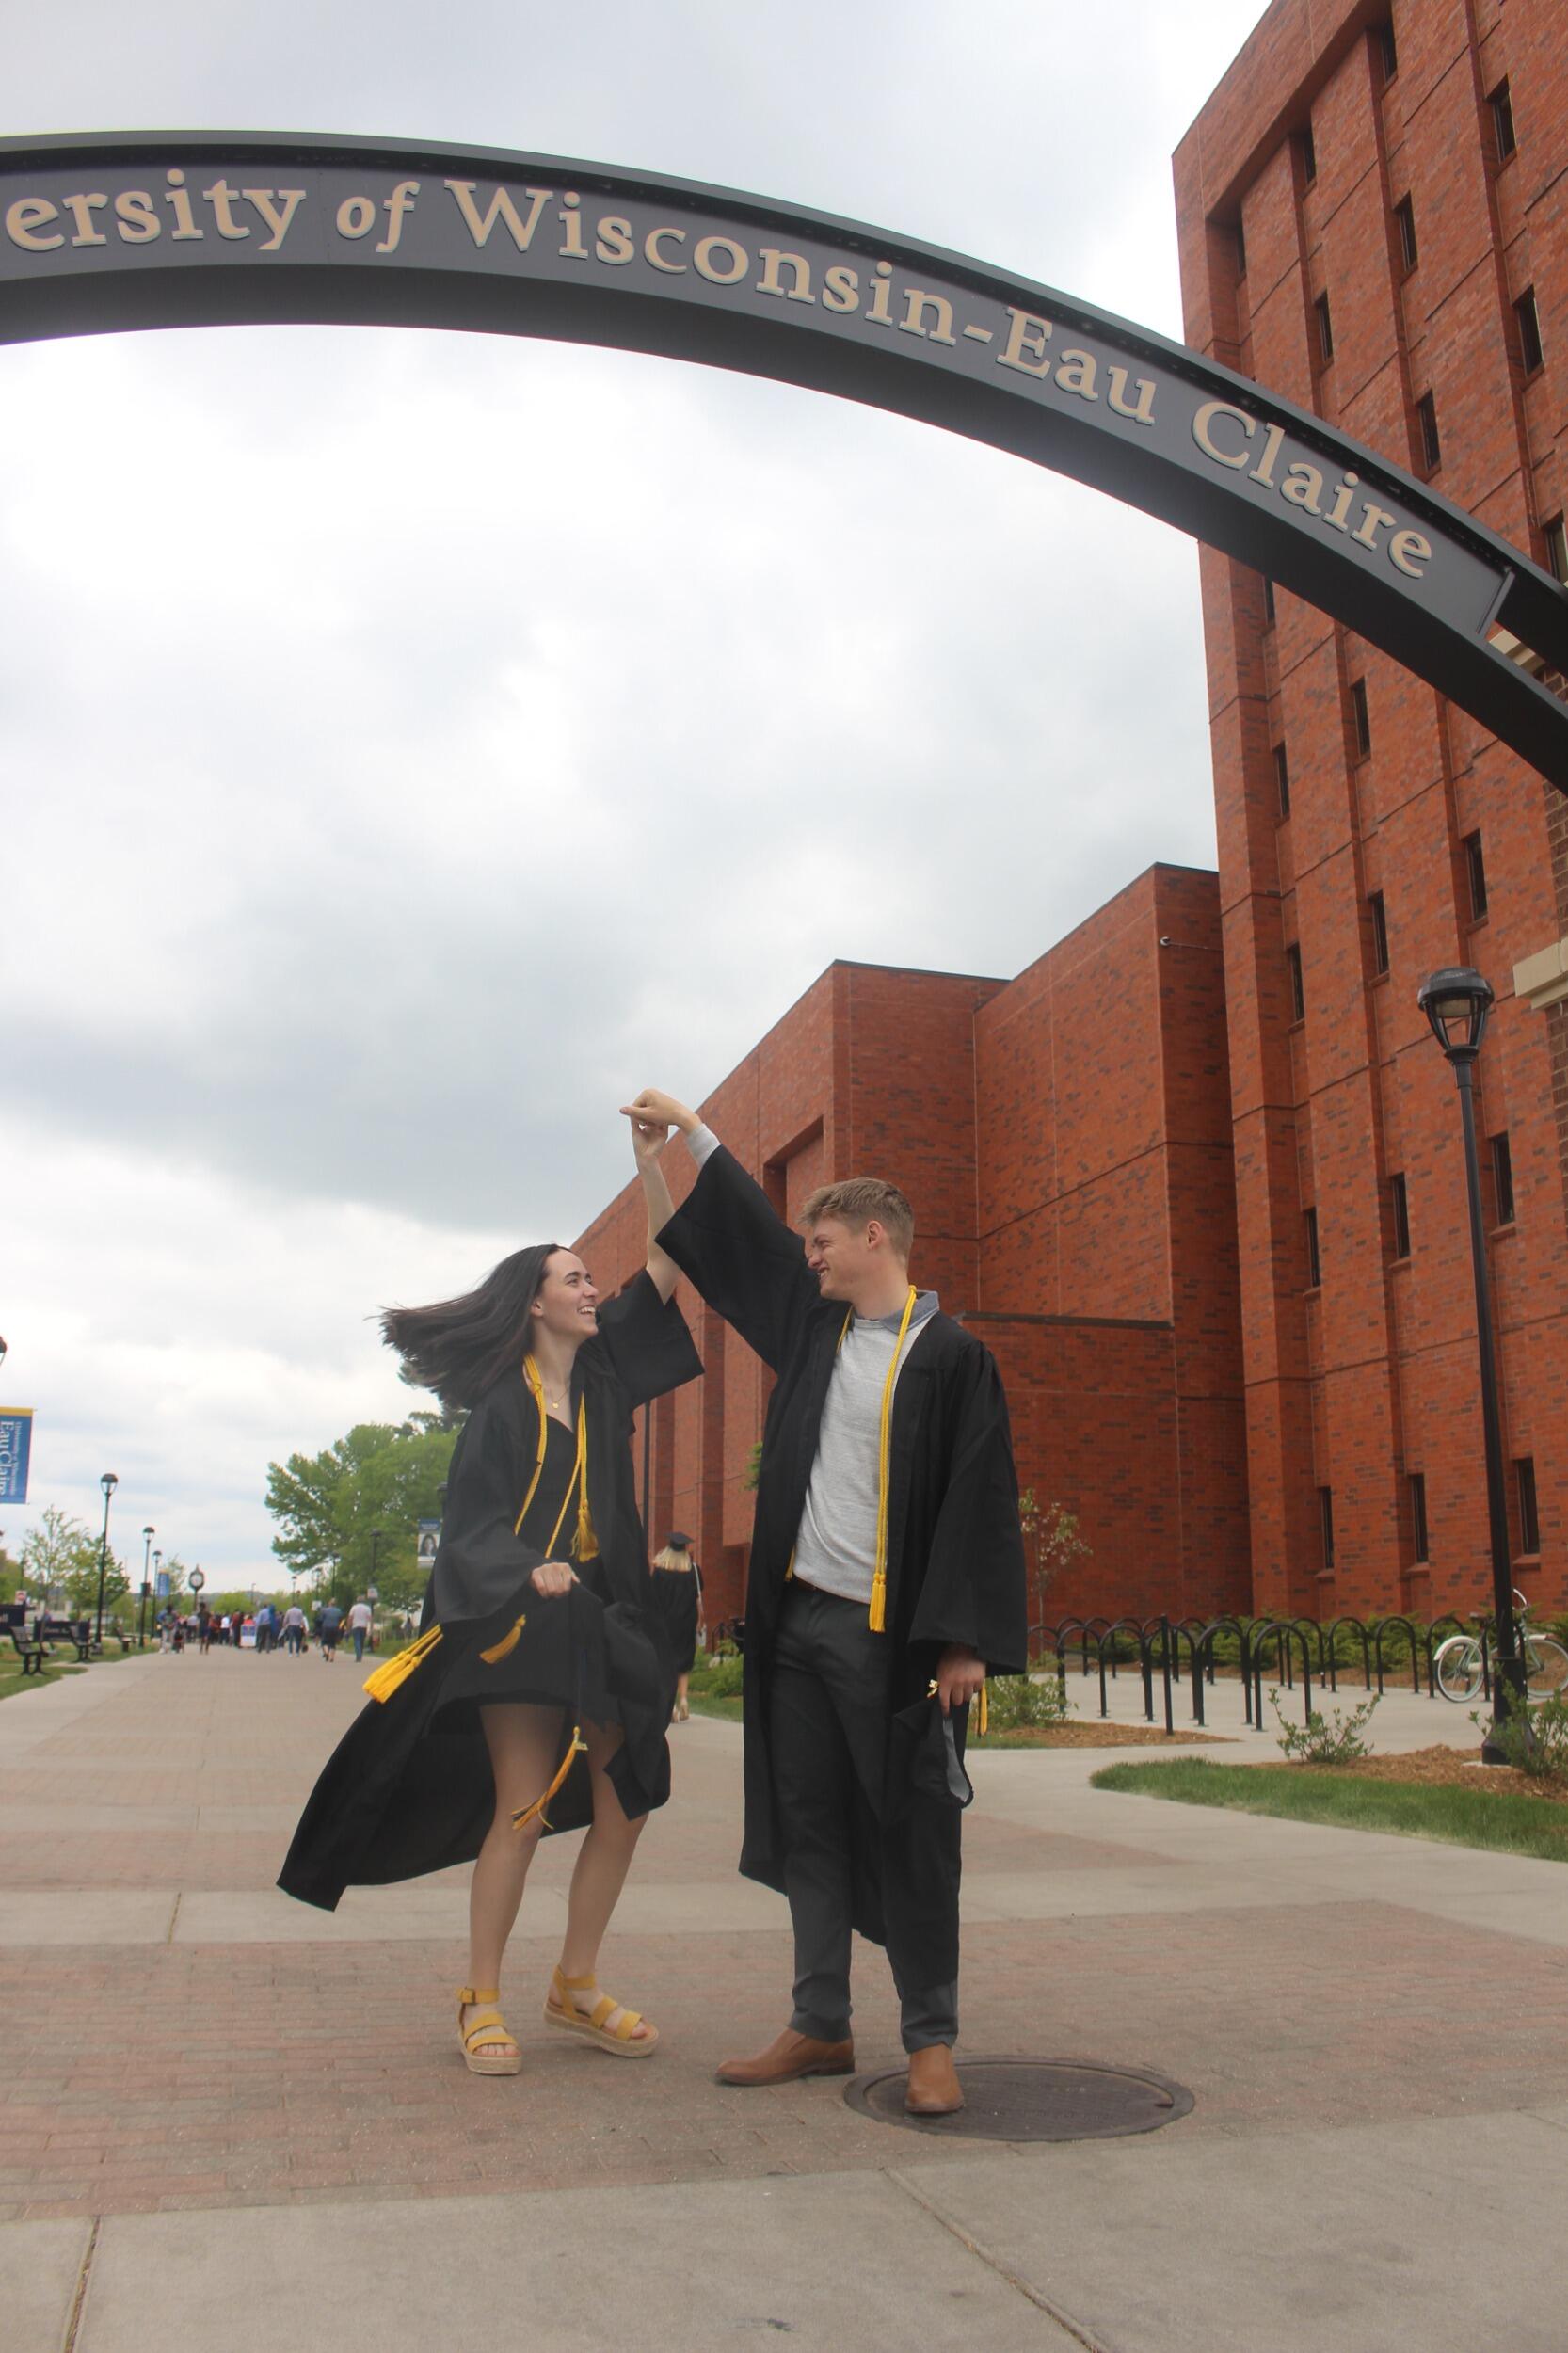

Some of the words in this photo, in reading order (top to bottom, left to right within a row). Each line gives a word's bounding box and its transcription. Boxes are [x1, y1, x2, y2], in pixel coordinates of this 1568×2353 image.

[5, 168, 307, 252] ersity
[335, 181, 421, 253] of
[1192, 400, 1432, 579] Claire
